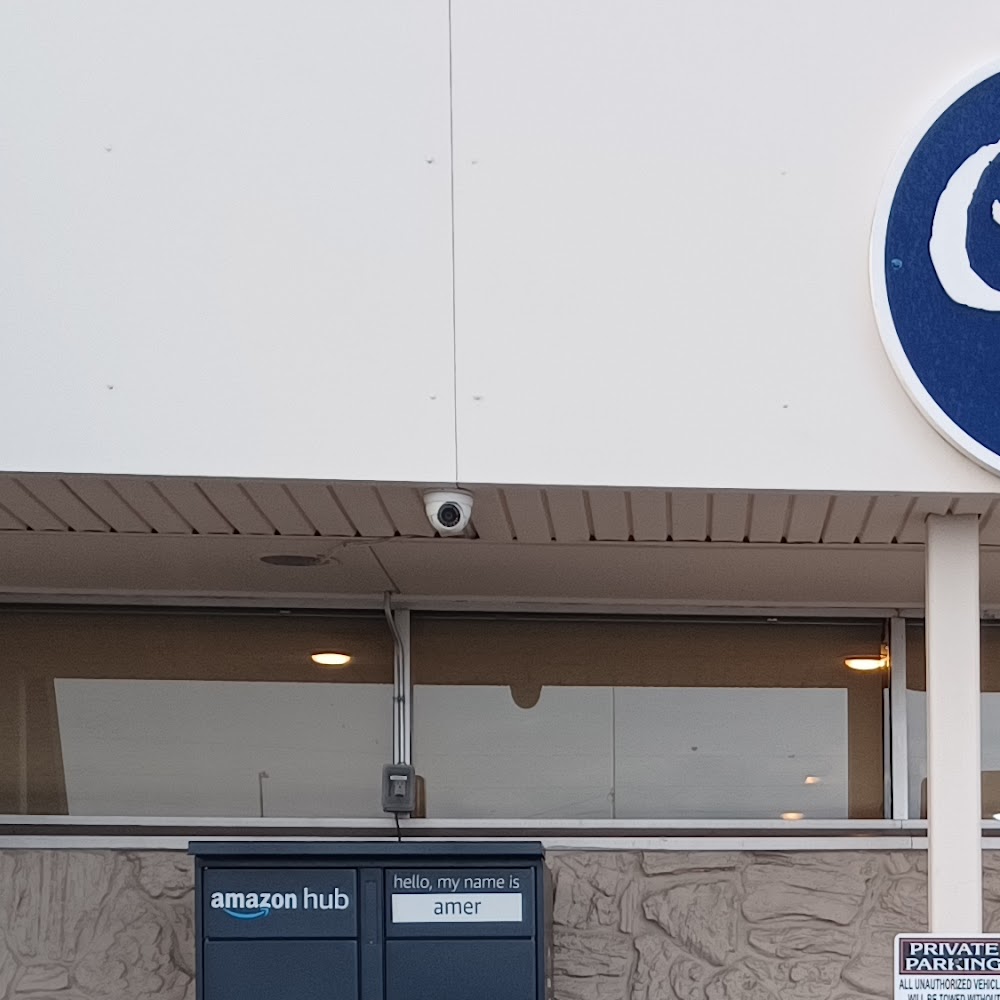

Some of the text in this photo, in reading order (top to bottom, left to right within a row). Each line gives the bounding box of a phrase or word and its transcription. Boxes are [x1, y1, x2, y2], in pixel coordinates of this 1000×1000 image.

[393, 874, 520, 892] hello, my name is
[210, 887, 349, 910] amazon hub
[433, 901, 481, 915] amer
[910, 942, 999, 956] PRIVATE
[899, 978, 913, 990] ALL
[915, 978, 972, 990] UNAUTHORIZED
